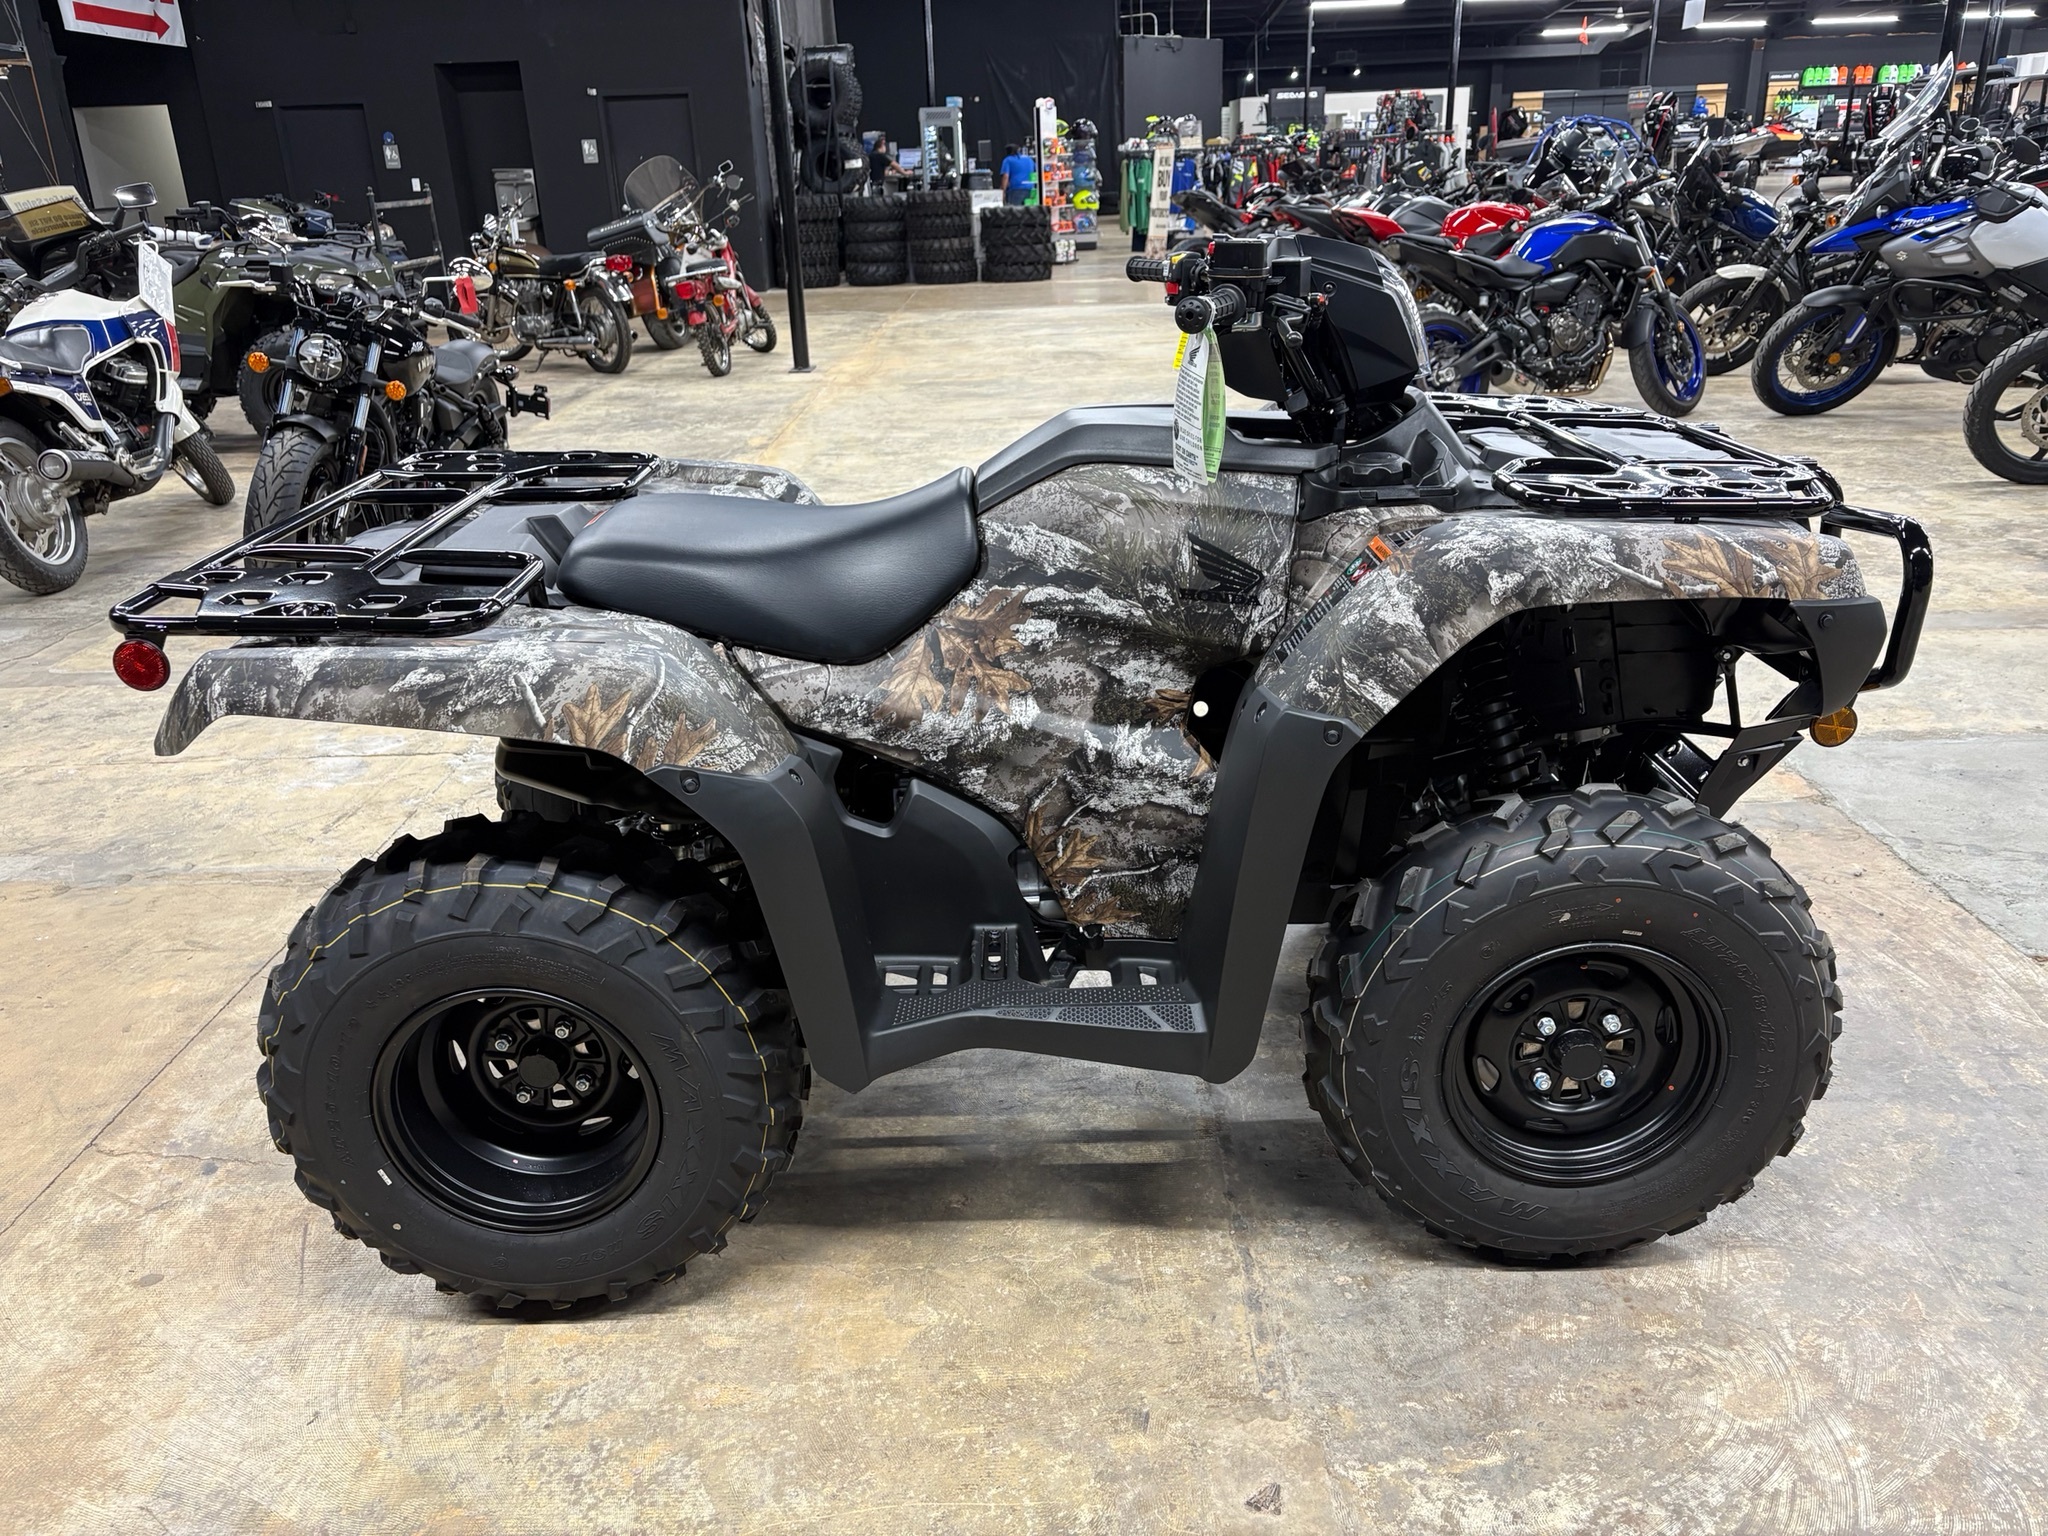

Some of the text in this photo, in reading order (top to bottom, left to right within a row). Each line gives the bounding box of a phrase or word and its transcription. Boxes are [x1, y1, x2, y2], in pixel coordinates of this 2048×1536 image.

[1158, 170, 1170, 187] BUY
[636, 1029, 706, 1241] MAXXIS
[1400, 1057, 1547, 1223] MAXXIS
